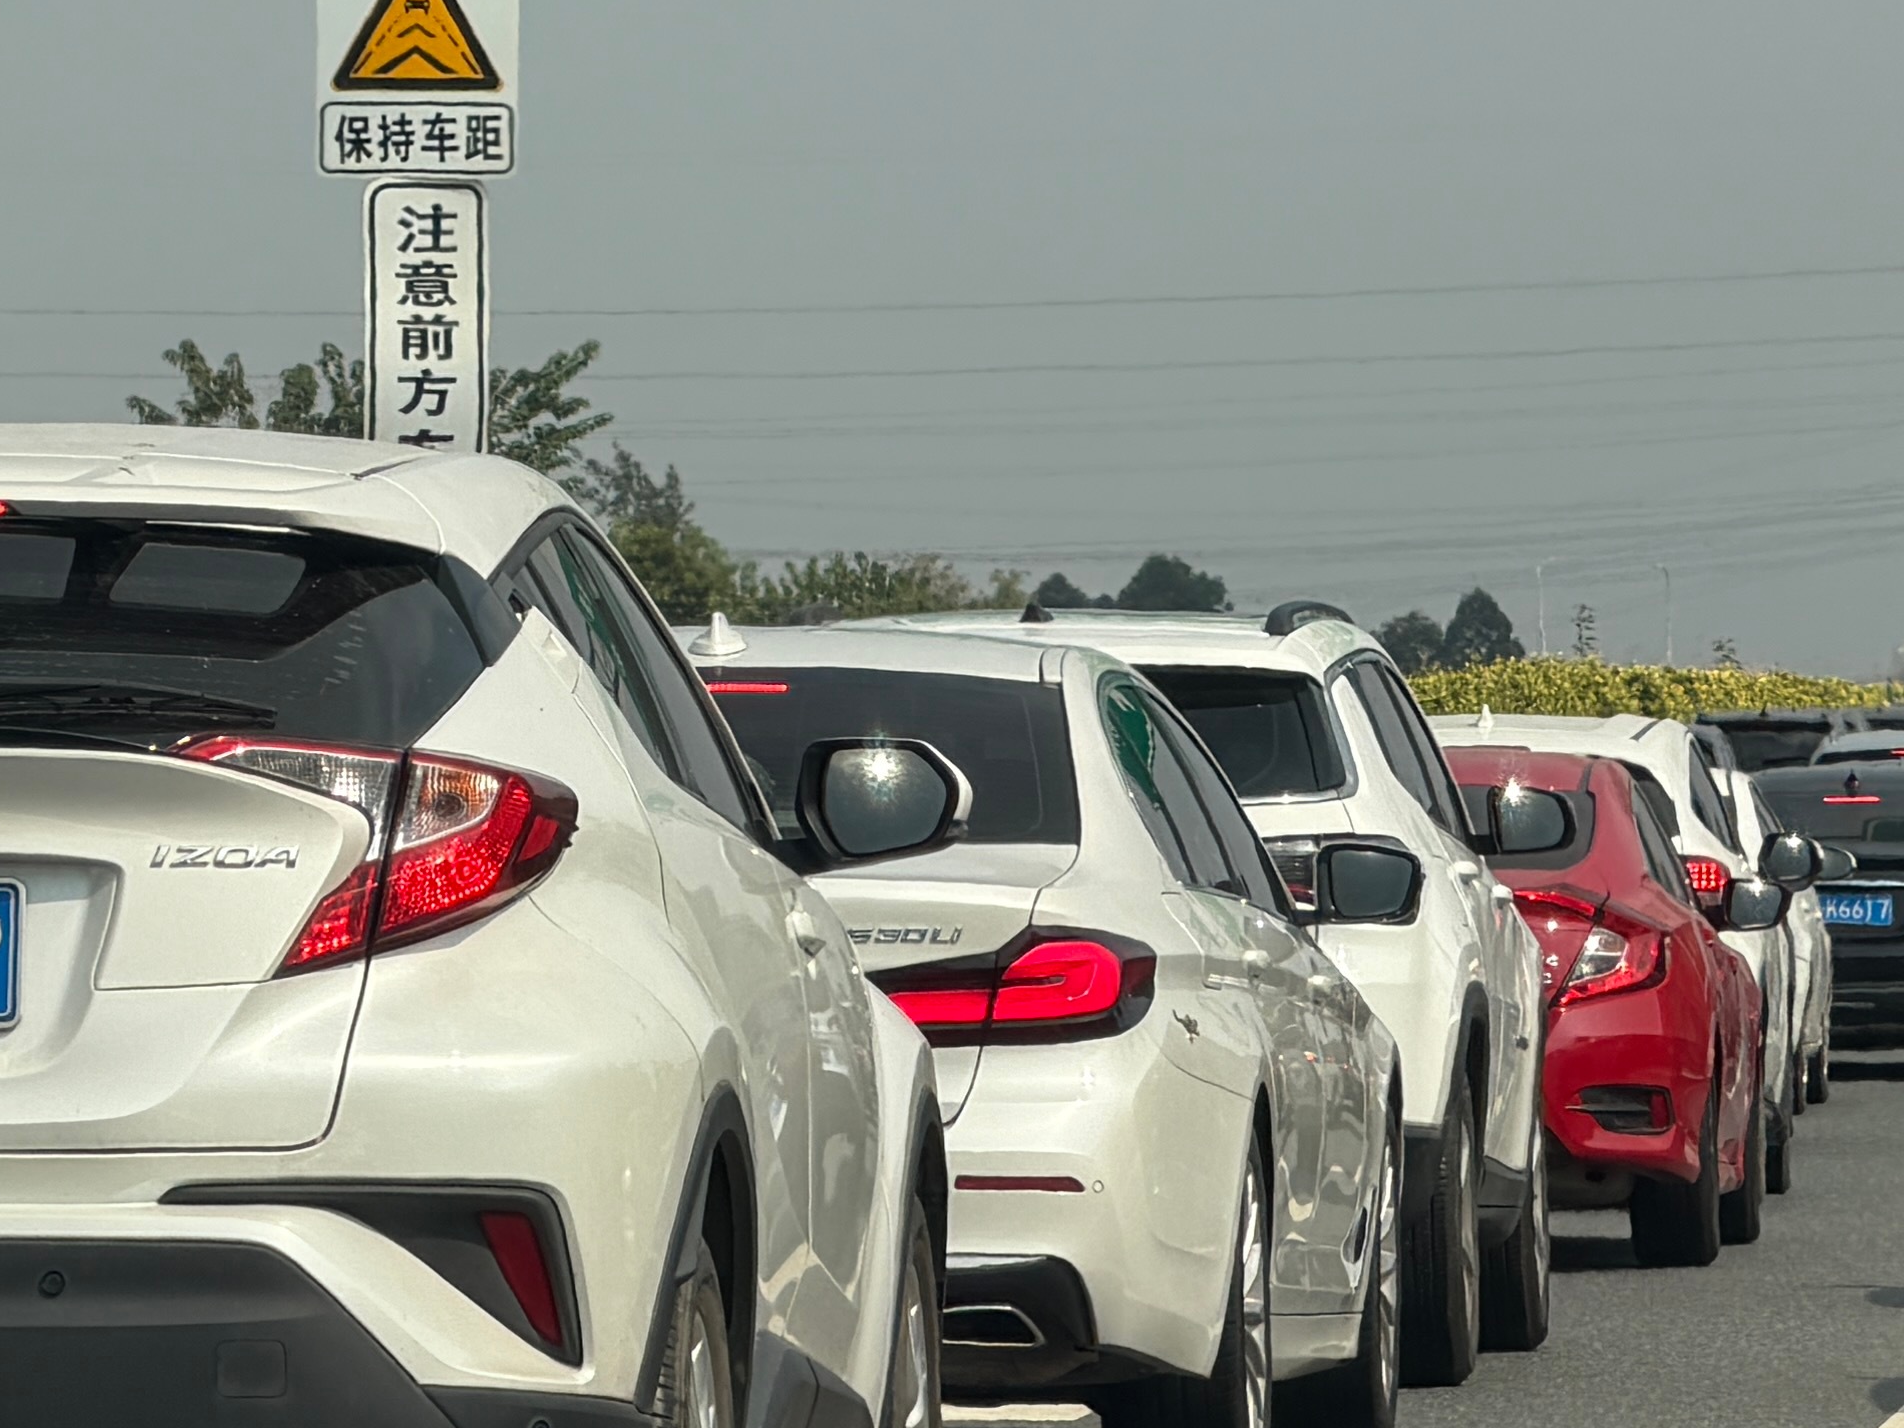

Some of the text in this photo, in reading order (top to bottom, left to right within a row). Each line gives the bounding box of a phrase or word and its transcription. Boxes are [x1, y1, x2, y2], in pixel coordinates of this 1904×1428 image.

[334, 112, 505, 165] 保持车距
[149, 844, 300, 869] IZOA
